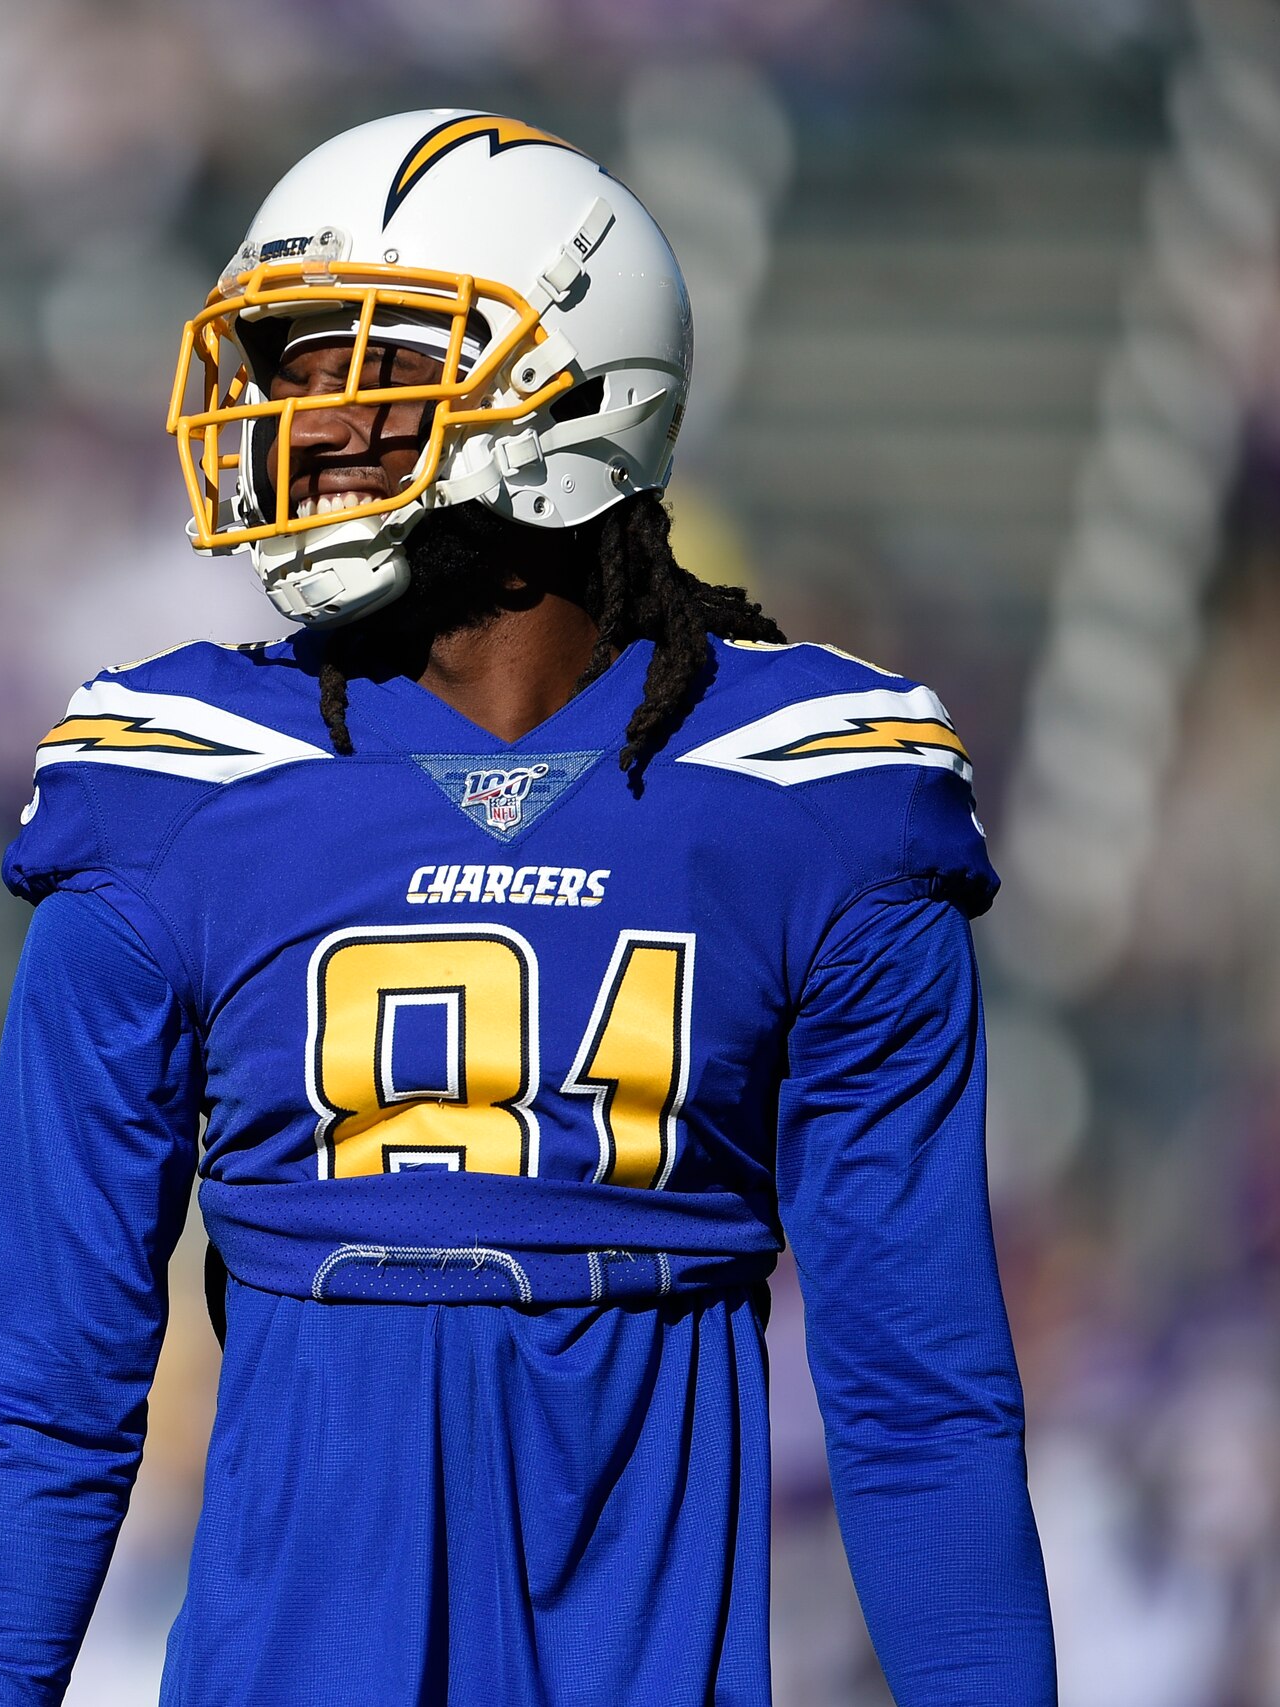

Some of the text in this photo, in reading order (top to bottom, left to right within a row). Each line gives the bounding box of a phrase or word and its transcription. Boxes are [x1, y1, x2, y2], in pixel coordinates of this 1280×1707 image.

[573, 232, 592, 254] 81
[468, 770, 530, 803] 100
[491, 806, 516, 821] NFL
[406, 864, 612, 907] CHARGERS
[304, 922, 696, 1191] 81
